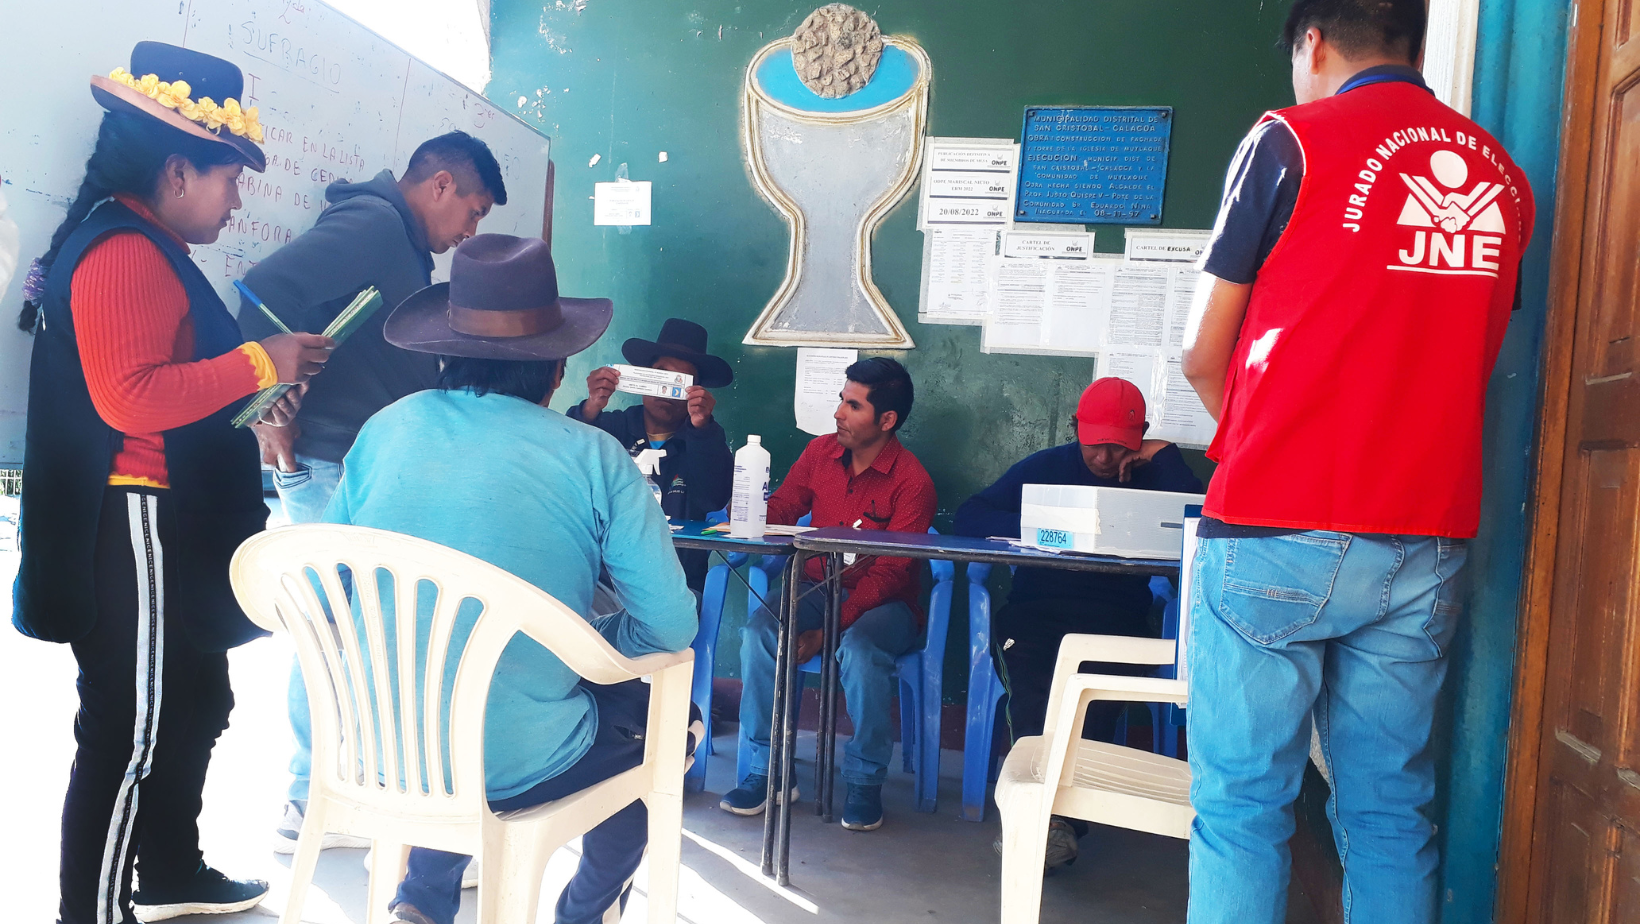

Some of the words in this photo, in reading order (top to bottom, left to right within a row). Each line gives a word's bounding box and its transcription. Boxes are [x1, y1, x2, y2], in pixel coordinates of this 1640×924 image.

[241, 21, 341, 85] SUFRAGIO
[1034, 115, 1100, 124] MUNICIPALIDAD
[303, 136, 317, 153] EN
[284, 158, 301, 176] DE
[236, 172, 282, 202] ABINA
[294, 192, 310, 209] DE
[1342, 158, 1383, 232] JURADO
[1376, 127, 1452, 160] NACIONAL
[1456, 132, 1477, 150] DE
[1482, 145, 1522, 243] ELECCI
[1398, 230, 1502, 271] JNE
[1040, 530, 1066, 544] 228764
